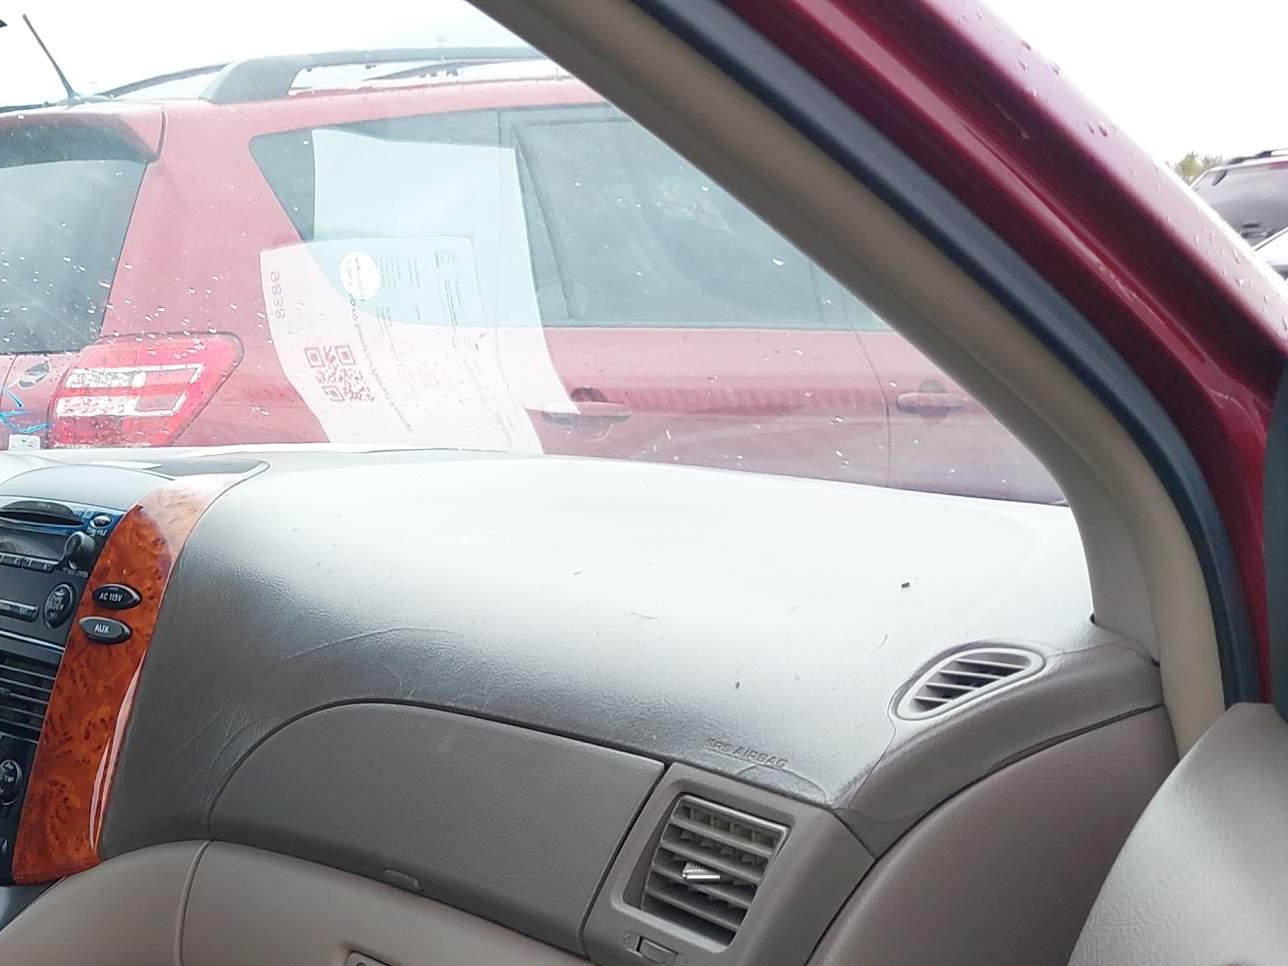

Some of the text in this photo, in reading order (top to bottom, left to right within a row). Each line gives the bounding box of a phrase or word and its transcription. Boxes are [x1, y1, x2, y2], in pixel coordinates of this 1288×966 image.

[94, 623, 110, 633] AUX
[703, 738, 789, 768] SRS AIRBAG
